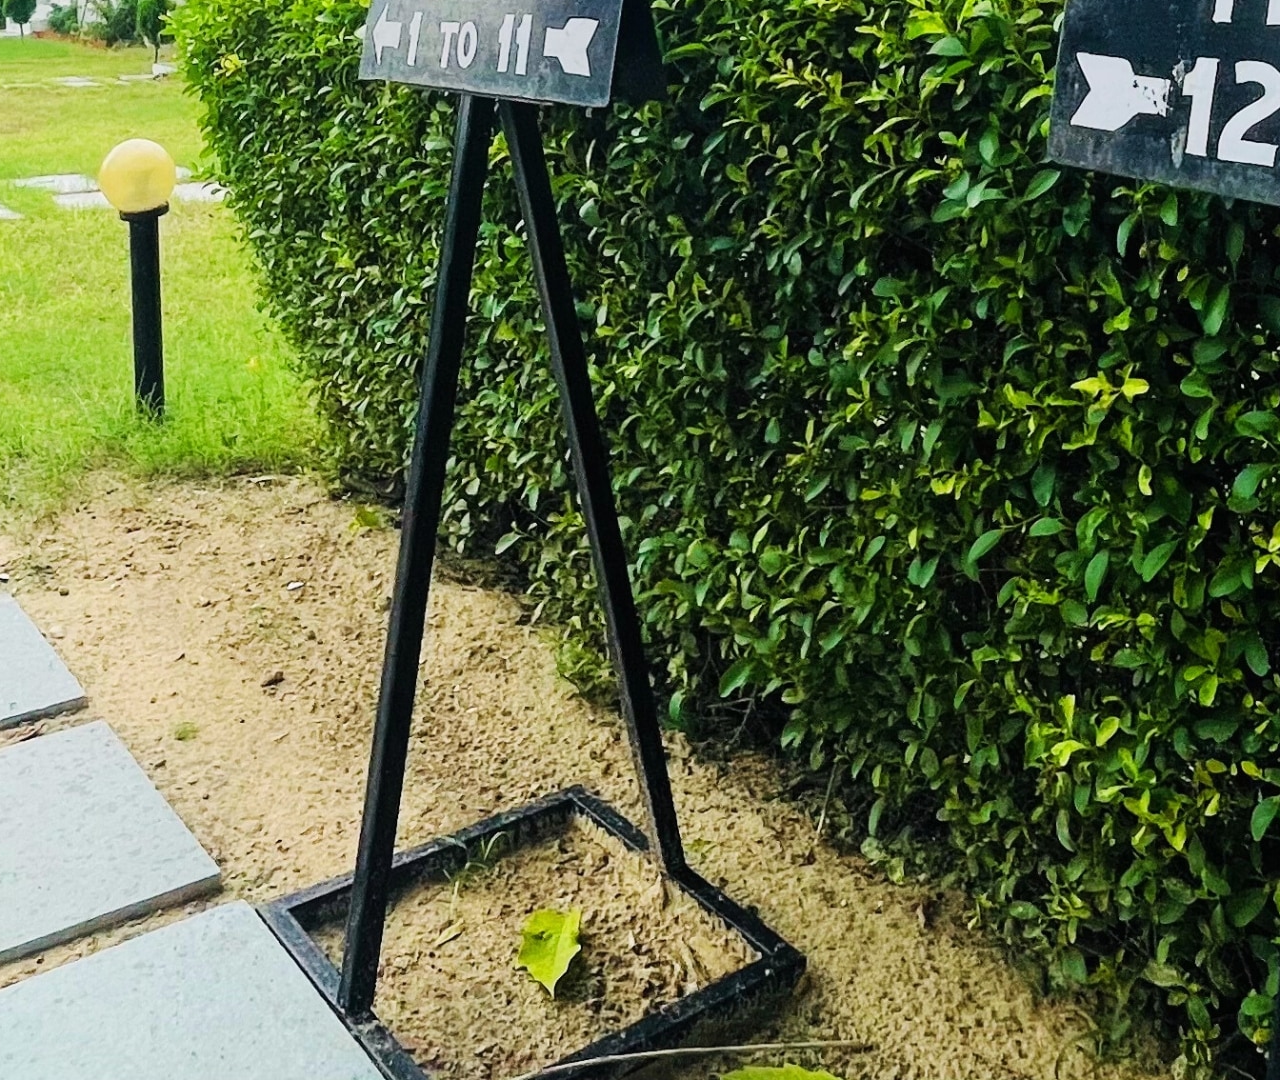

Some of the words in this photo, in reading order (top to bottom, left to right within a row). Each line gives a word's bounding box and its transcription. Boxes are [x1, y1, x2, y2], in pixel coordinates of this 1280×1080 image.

[407, 11, 423, 66] 1
[440, 21, 478, 69] TO
[497, 13, 533, 75] 11
